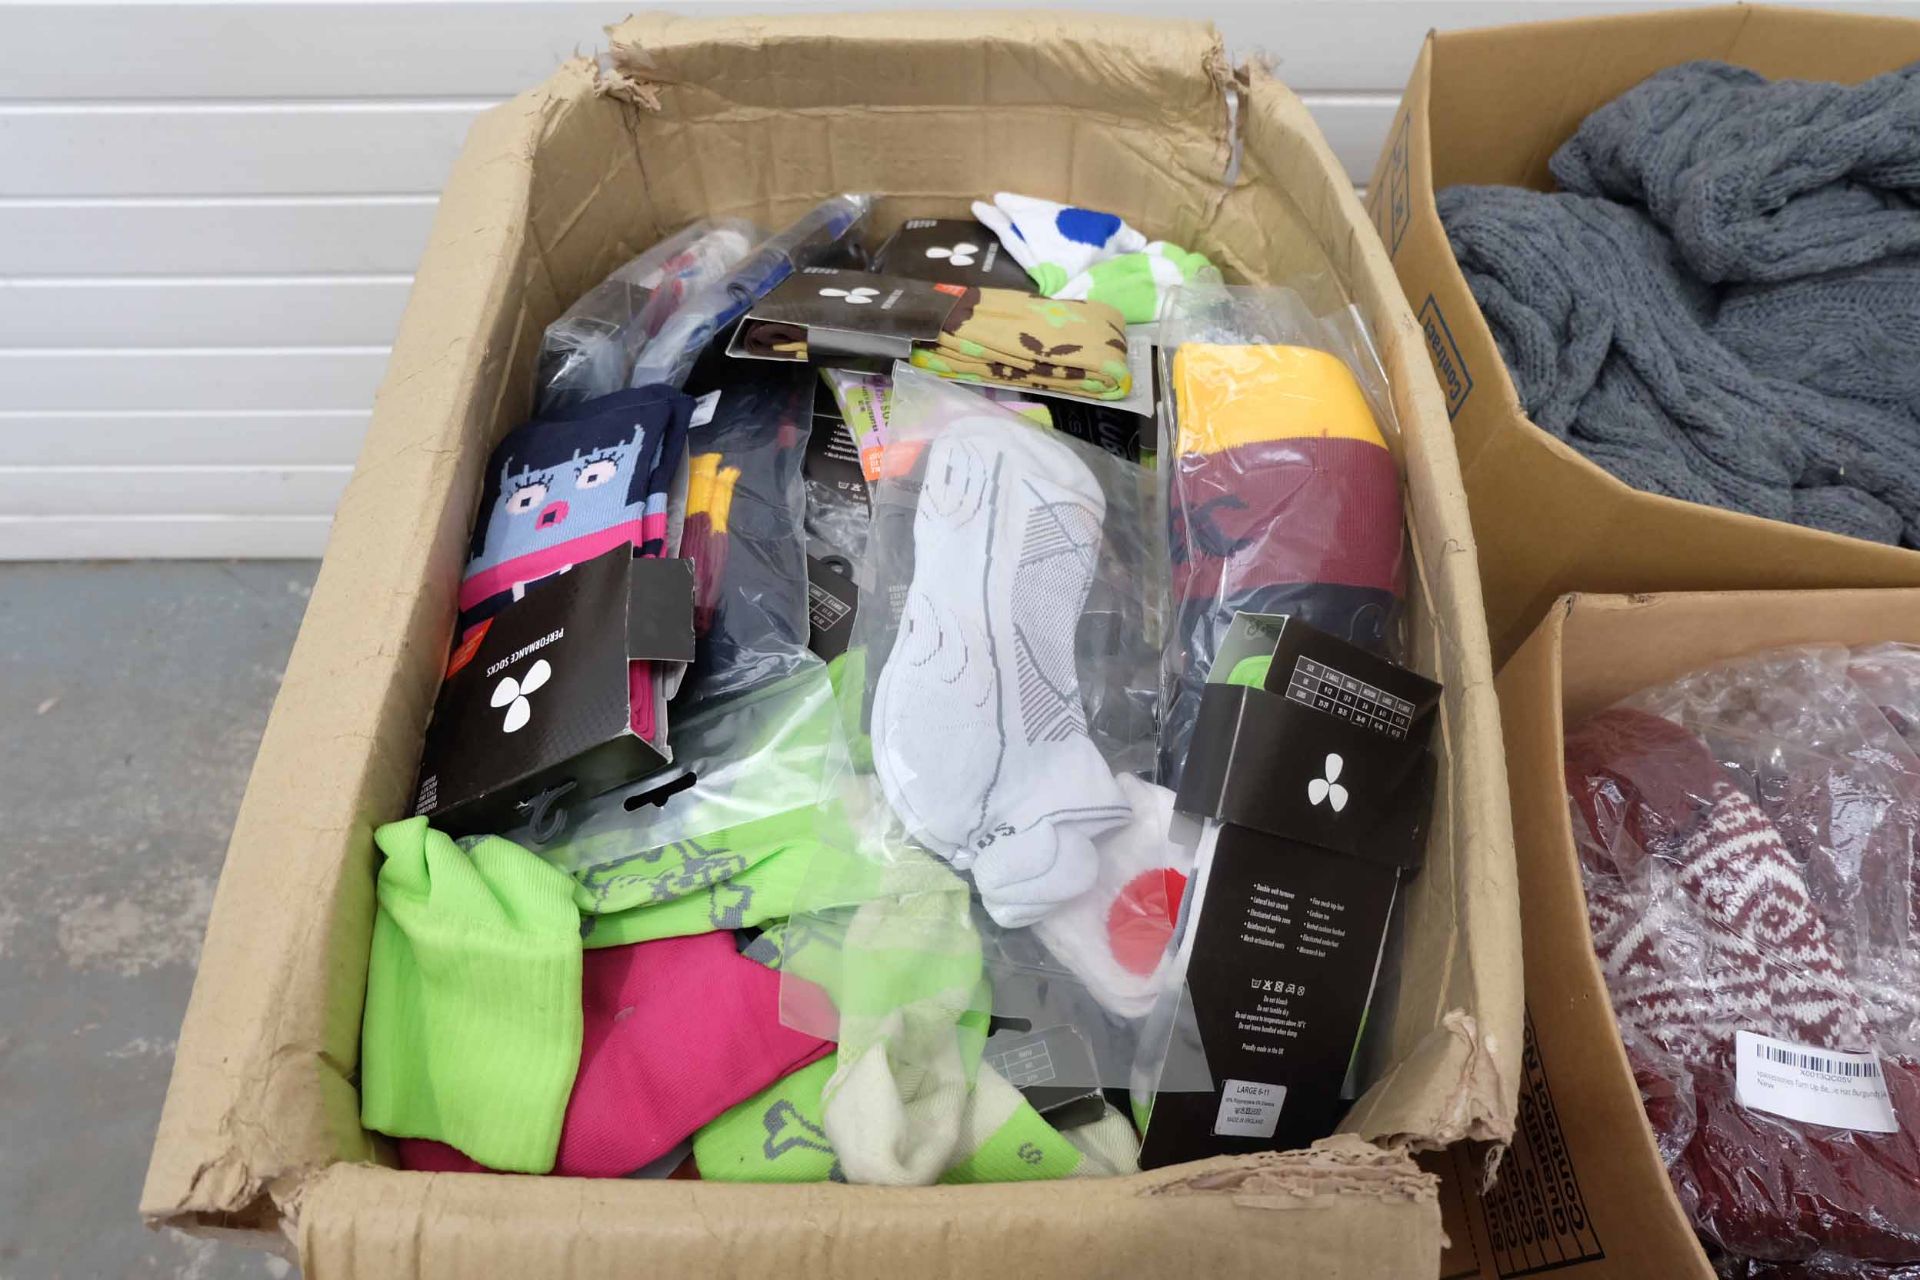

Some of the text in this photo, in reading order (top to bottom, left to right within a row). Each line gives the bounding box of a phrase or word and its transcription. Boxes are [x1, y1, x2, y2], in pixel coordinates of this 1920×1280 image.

[487, 657, 509, 677] SOCKS
[511, 628, 564, 663] PERFORMANCE
[1236, 1085, 1269, 1096] LARGE 6-11
[1520, 1093, 1567, 1236] Quantity
[1533, 1080, 1585, 1231] Contract
[1503, 1146, 1533, 1245] Colou
[1525, 1168, 1549, 1241] Size
